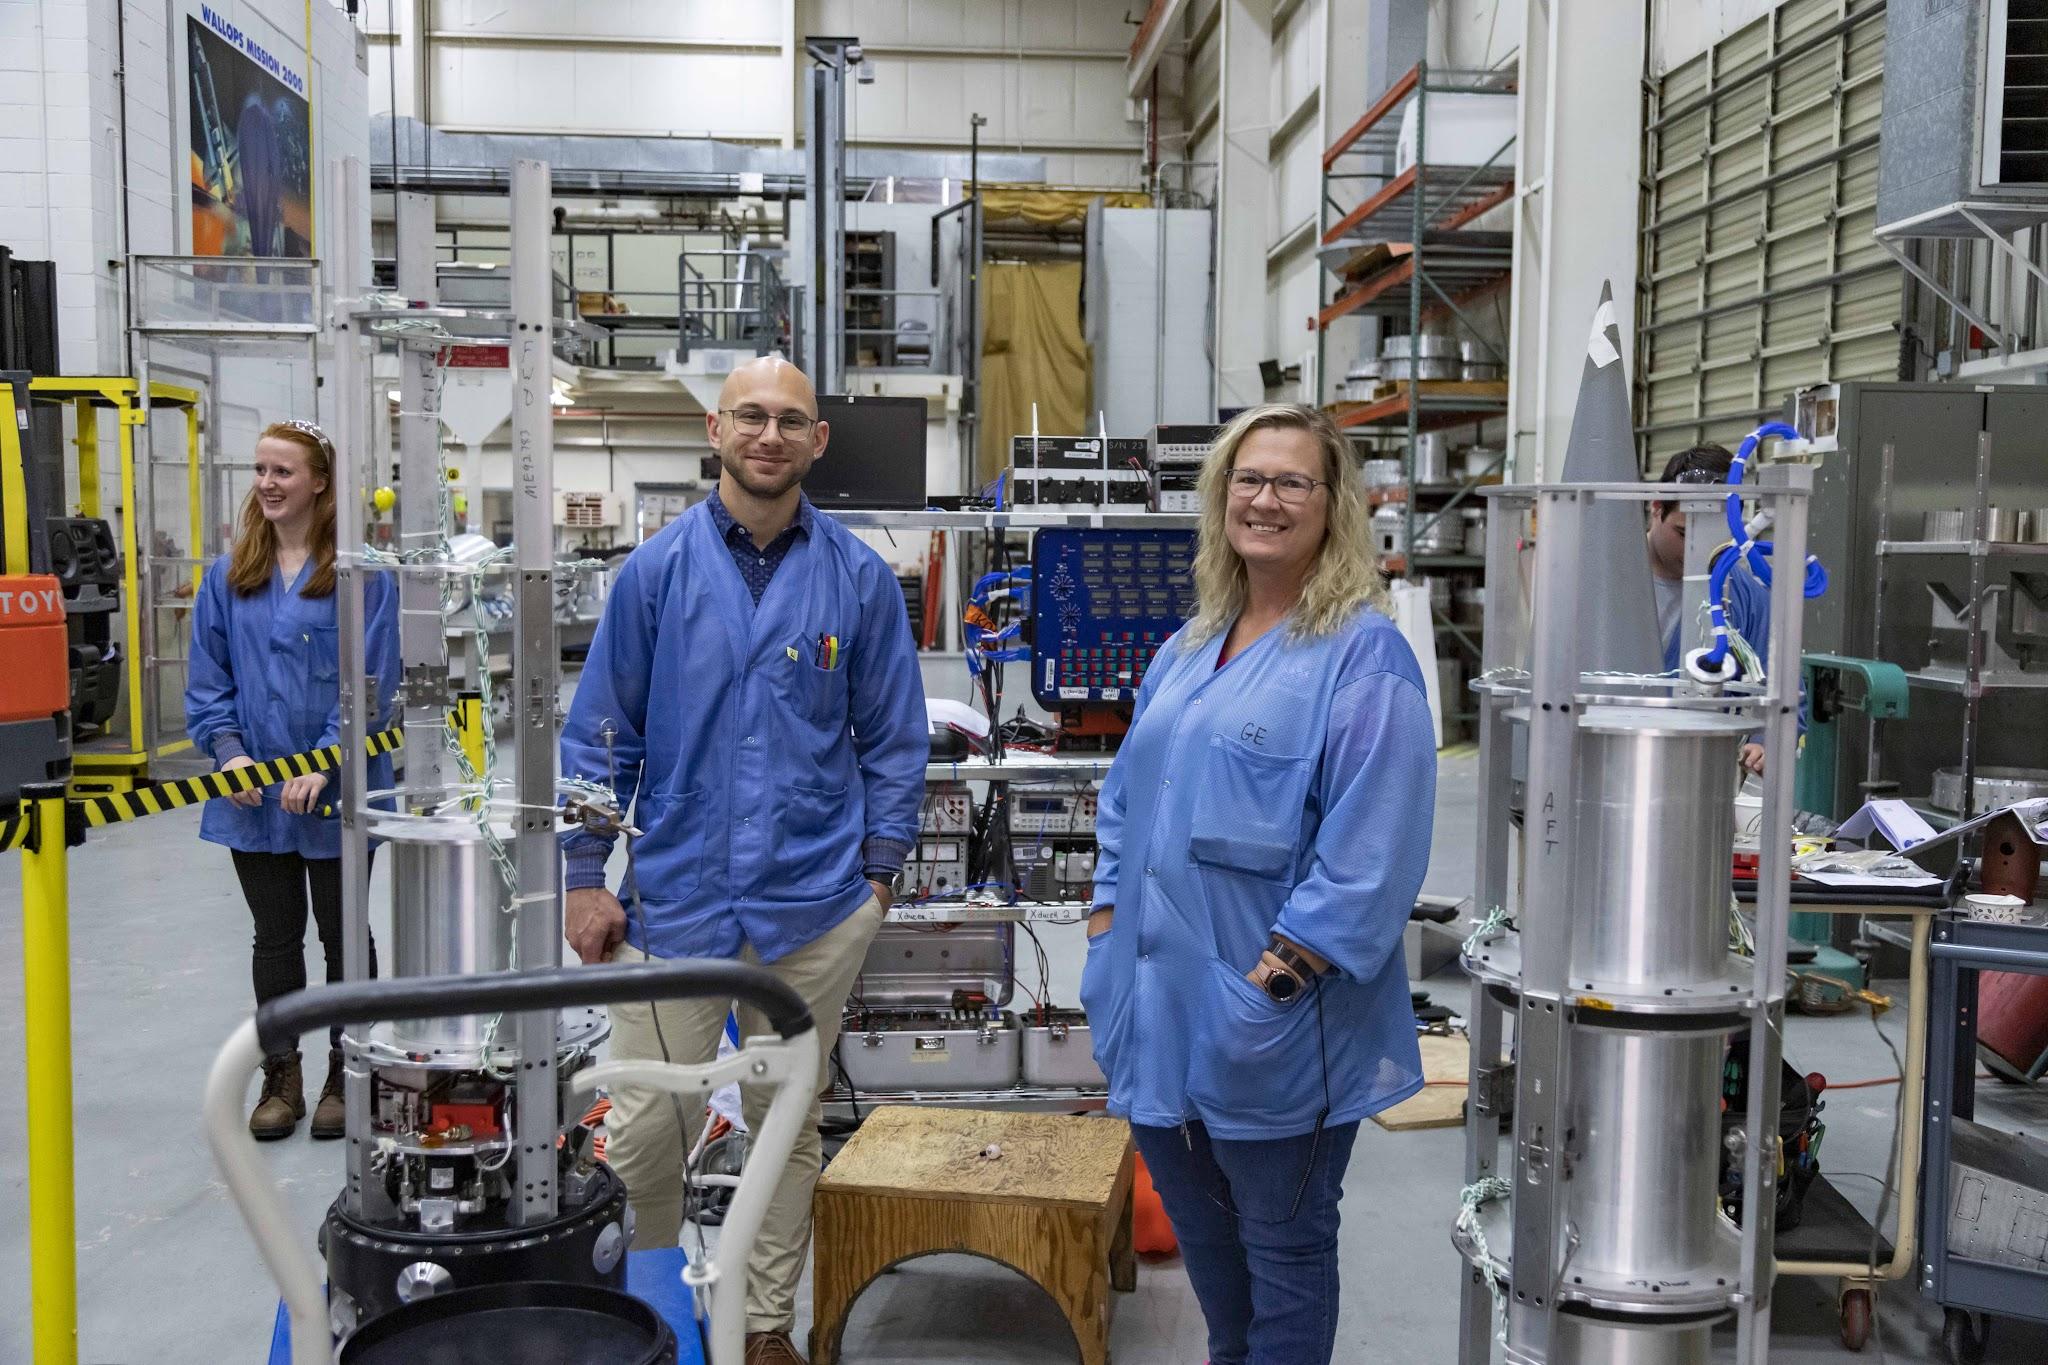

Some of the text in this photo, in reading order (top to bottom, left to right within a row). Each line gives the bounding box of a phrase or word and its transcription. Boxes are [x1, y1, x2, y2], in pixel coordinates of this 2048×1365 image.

[201, 3, 303, 93] WALLOPS MISSION 2000
[1108, 441, 1144, 450] S/N 23
[1240, 722, 1267, 746] GE
[1542, 792, 1560, 855] AFT
[1063, 909, 1072, 919] 2
